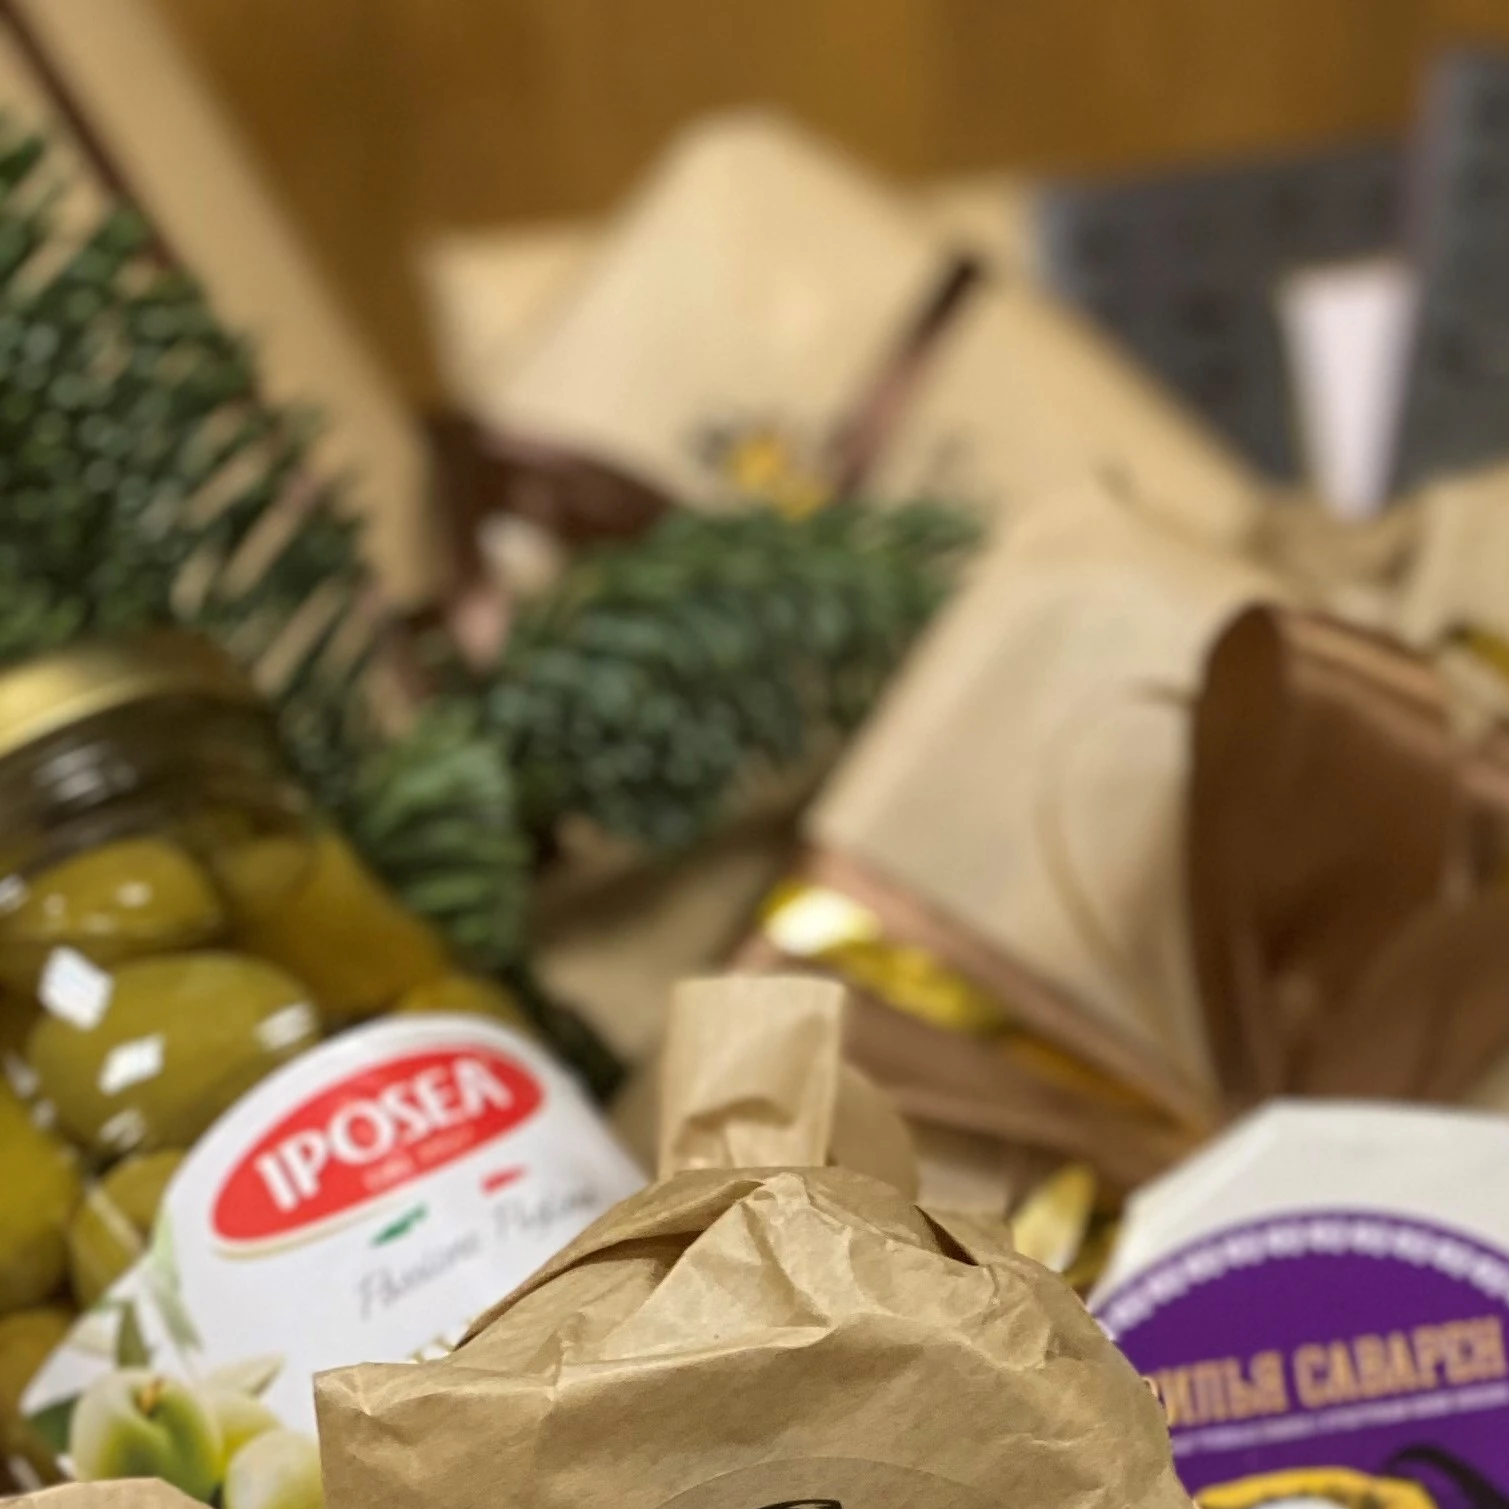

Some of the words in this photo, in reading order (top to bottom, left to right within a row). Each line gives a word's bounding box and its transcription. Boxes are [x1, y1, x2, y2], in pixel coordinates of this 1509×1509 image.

[255, 1056, 514, 1212] IPOSEA
[1142, 1348, 1289, 1427] ИЛЬЯ
[1292, 1314, 1509, 1409] САВАРЕН
